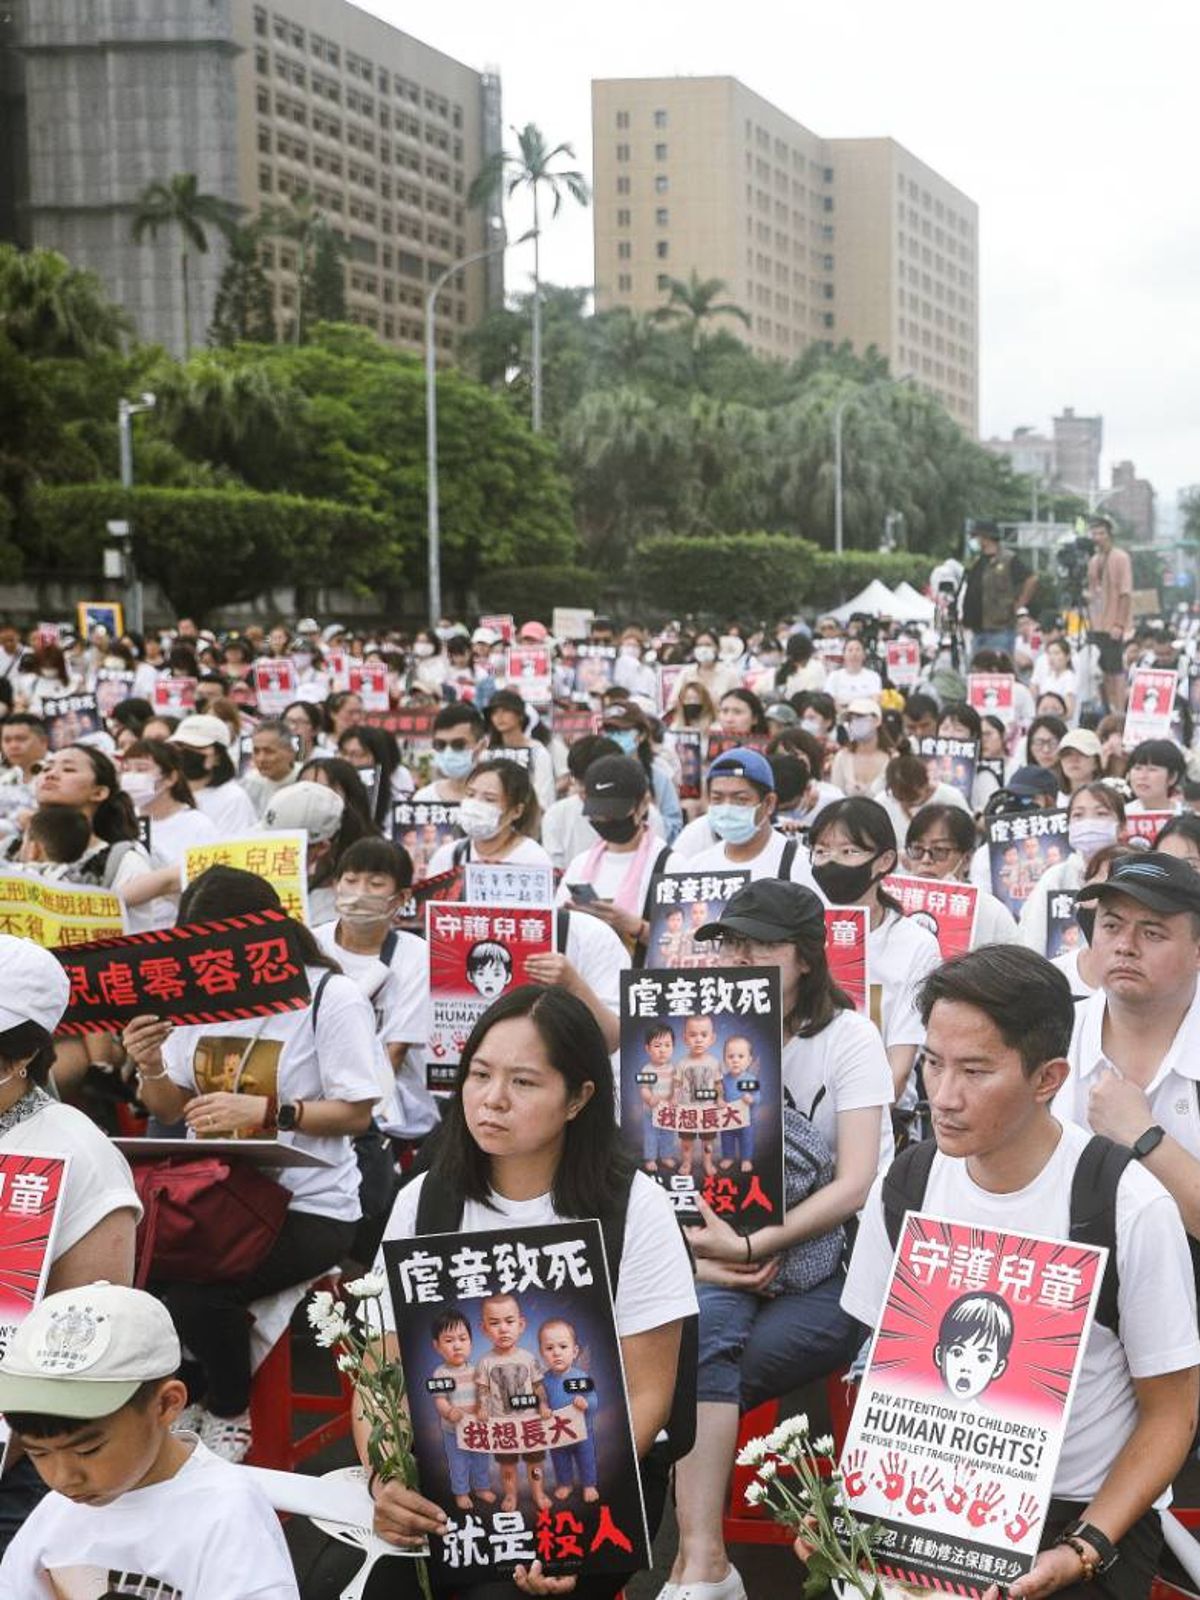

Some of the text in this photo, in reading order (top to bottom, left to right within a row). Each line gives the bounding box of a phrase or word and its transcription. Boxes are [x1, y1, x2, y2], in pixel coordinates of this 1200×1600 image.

[435, 913, 546, 943] 守護兒童
[628, 976, 772, 1017] 虐童致死
[657, 1104, 743, 1130] 我想長大
[0, 1173, 50, 1217] 童
[651, 1174, 773, 1214] 是殺人
[398, 1239, 594, 1304] 虐童致死
[908, 1237, 1083, 1310] 守護兒童
[463, 1413, 578, 1450] 我想長大
[871, 1391, 1048, 1442] PAY ATTENTION TO CHILDREN'S
[860, 1432, 893, 1449] REFUSE
[907, 1442, 925, 1455] LET
[927, 1448, 966, 1465] TRAGEDY
[863, 1407, 1044, 1469] HUMAN RIGHTS!
[443, 1504, 633, 1568] 就是殺人
